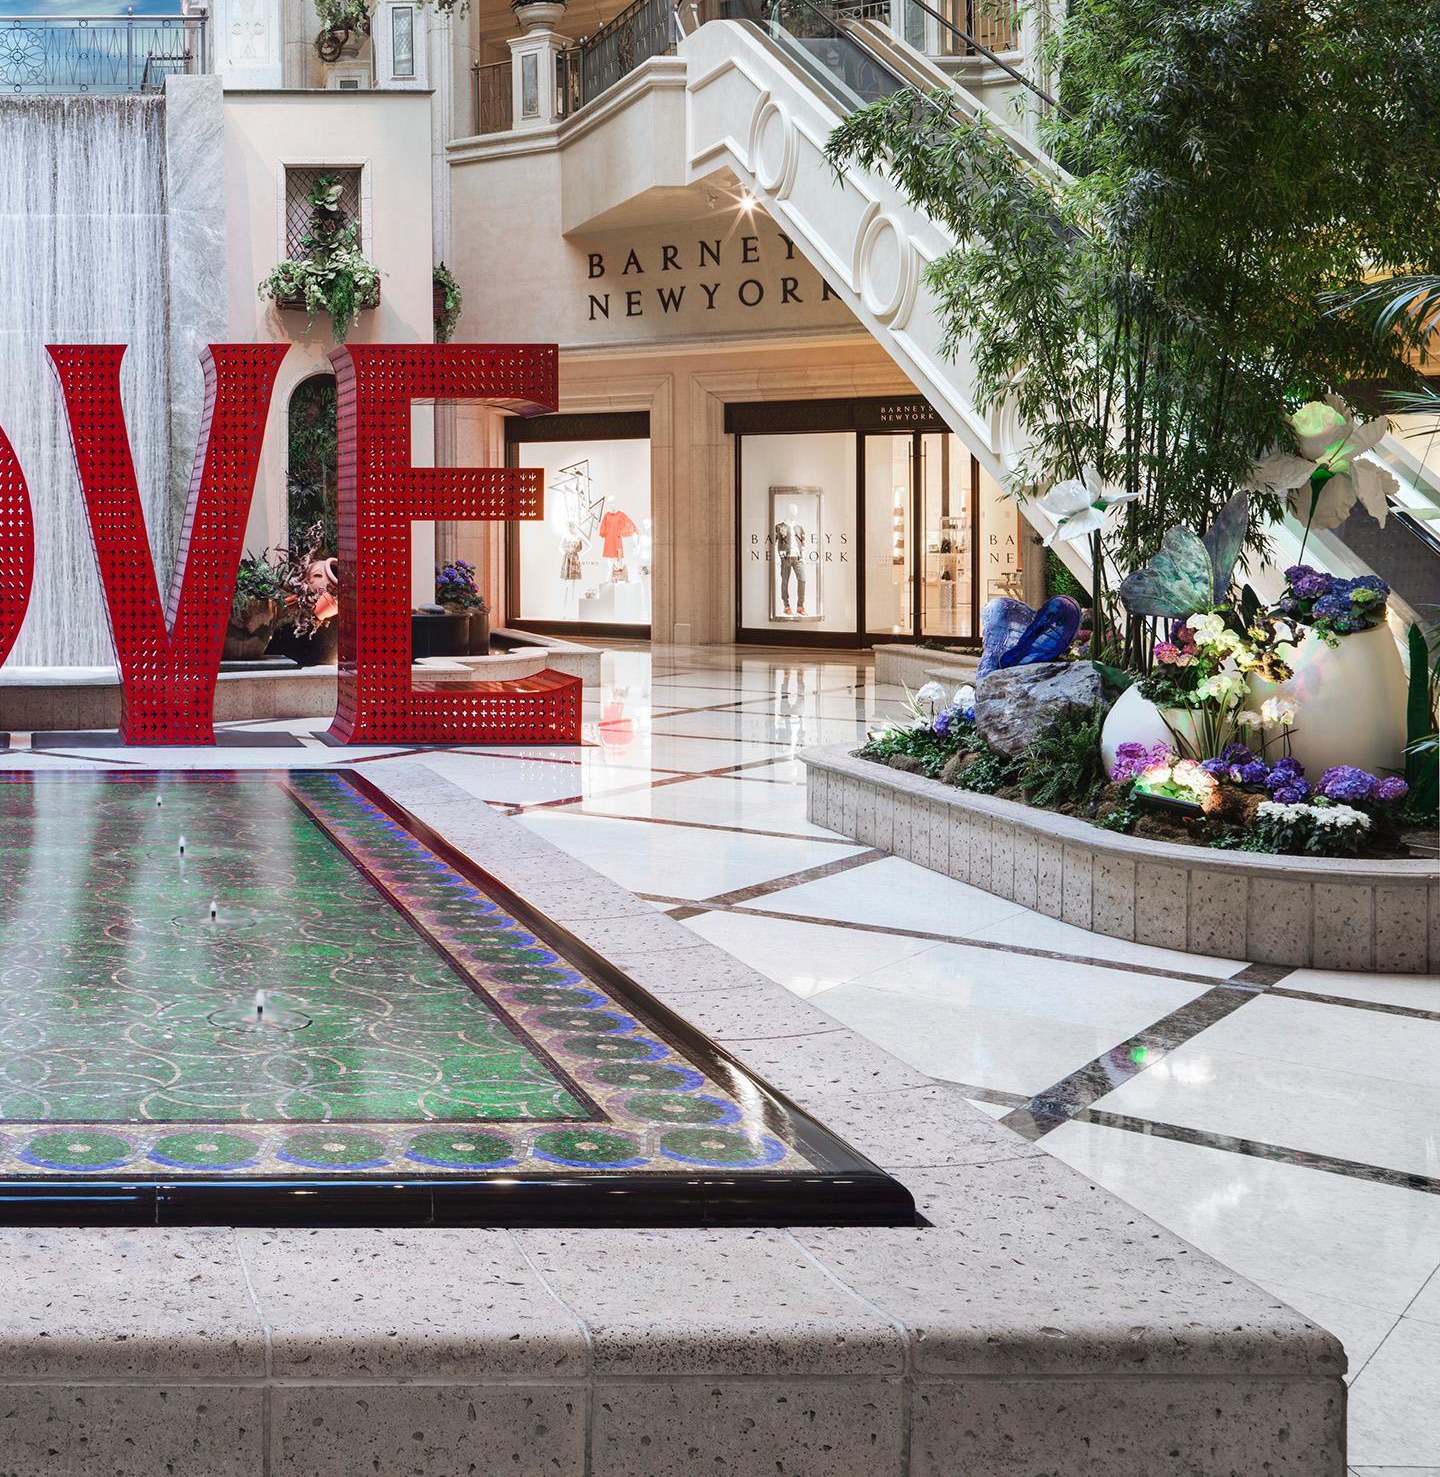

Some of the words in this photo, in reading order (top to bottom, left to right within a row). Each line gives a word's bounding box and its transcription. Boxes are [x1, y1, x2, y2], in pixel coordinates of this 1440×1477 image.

[880, 405, 934, 414] BARNEYS
[989, 534, 1015, 546] BA
[989, 552, 1015, 564] NE
